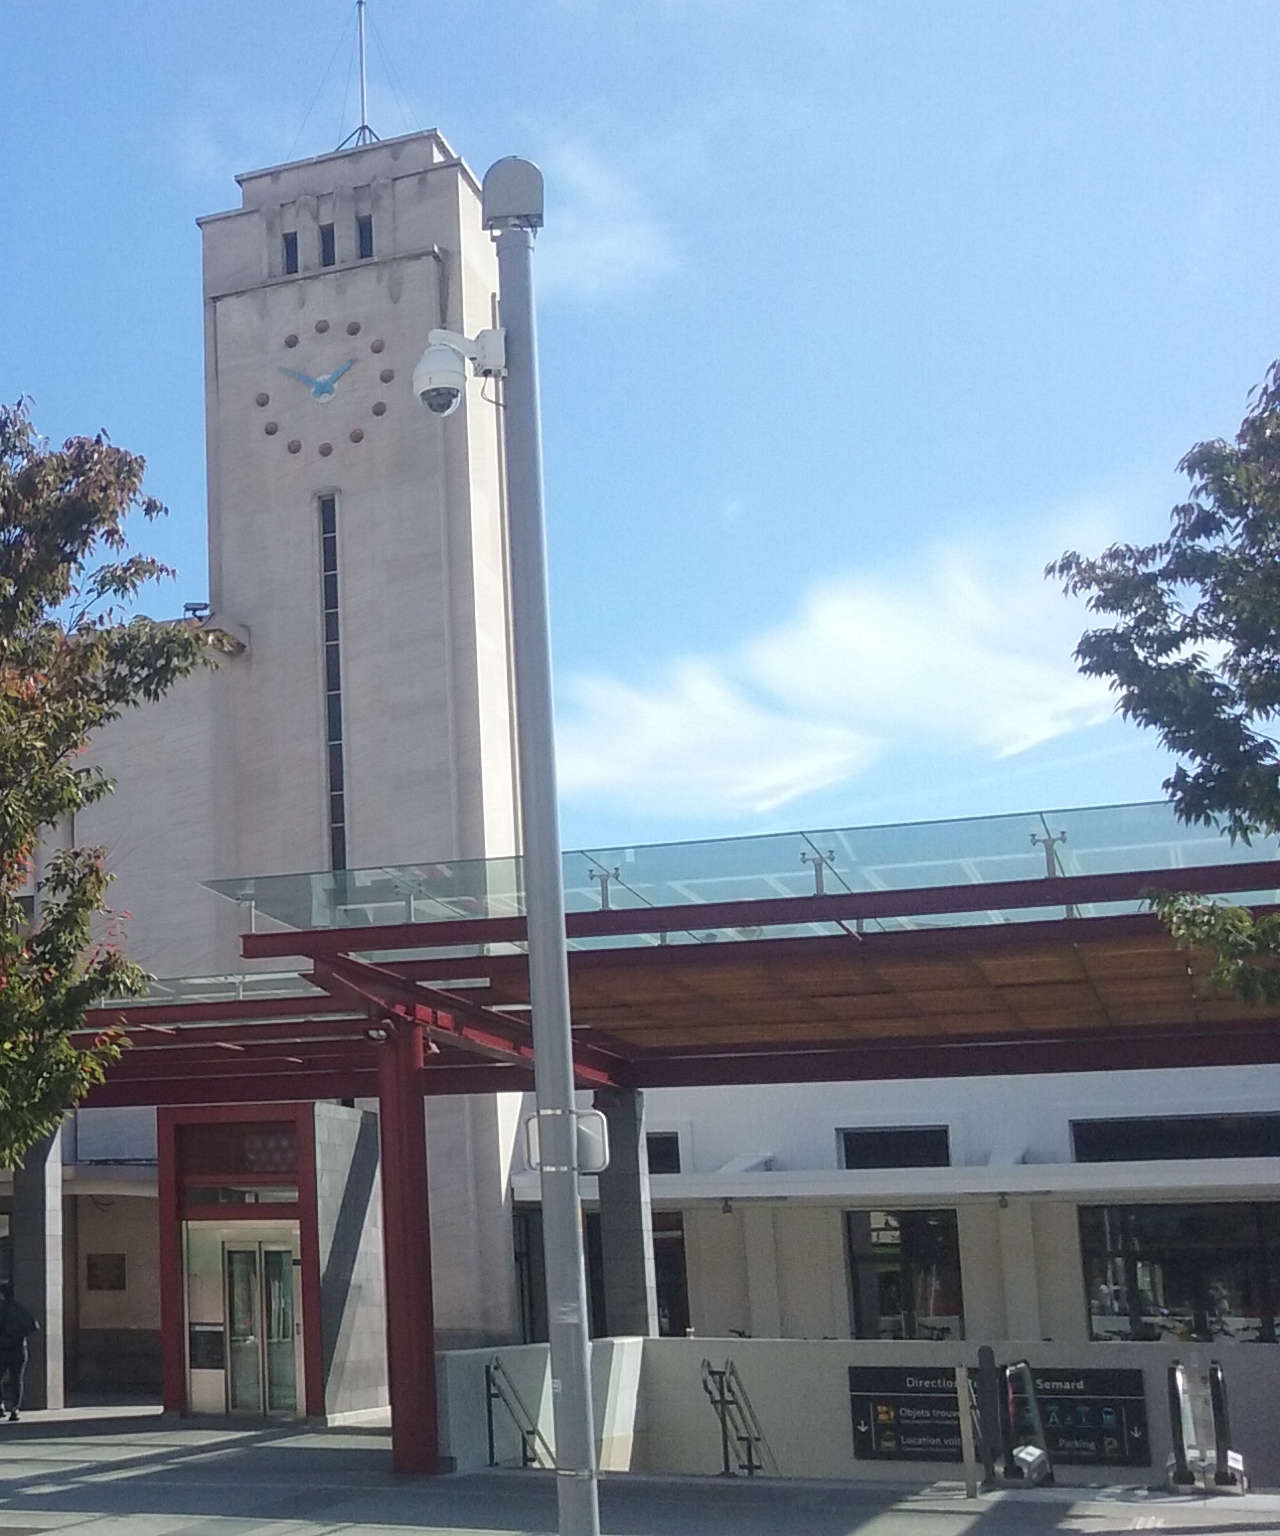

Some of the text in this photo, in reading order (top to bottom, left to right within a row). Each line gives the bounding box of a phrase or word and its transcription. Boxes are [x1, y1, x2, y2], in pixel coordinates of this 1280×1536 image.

[906, 1377, 1084, 1389] Directio Semard
[900, 1407, 930, 1419] Objets
[901, 1435, 963, 1446] Location voit
[1058, 1438, 1096, 1451] Parking
